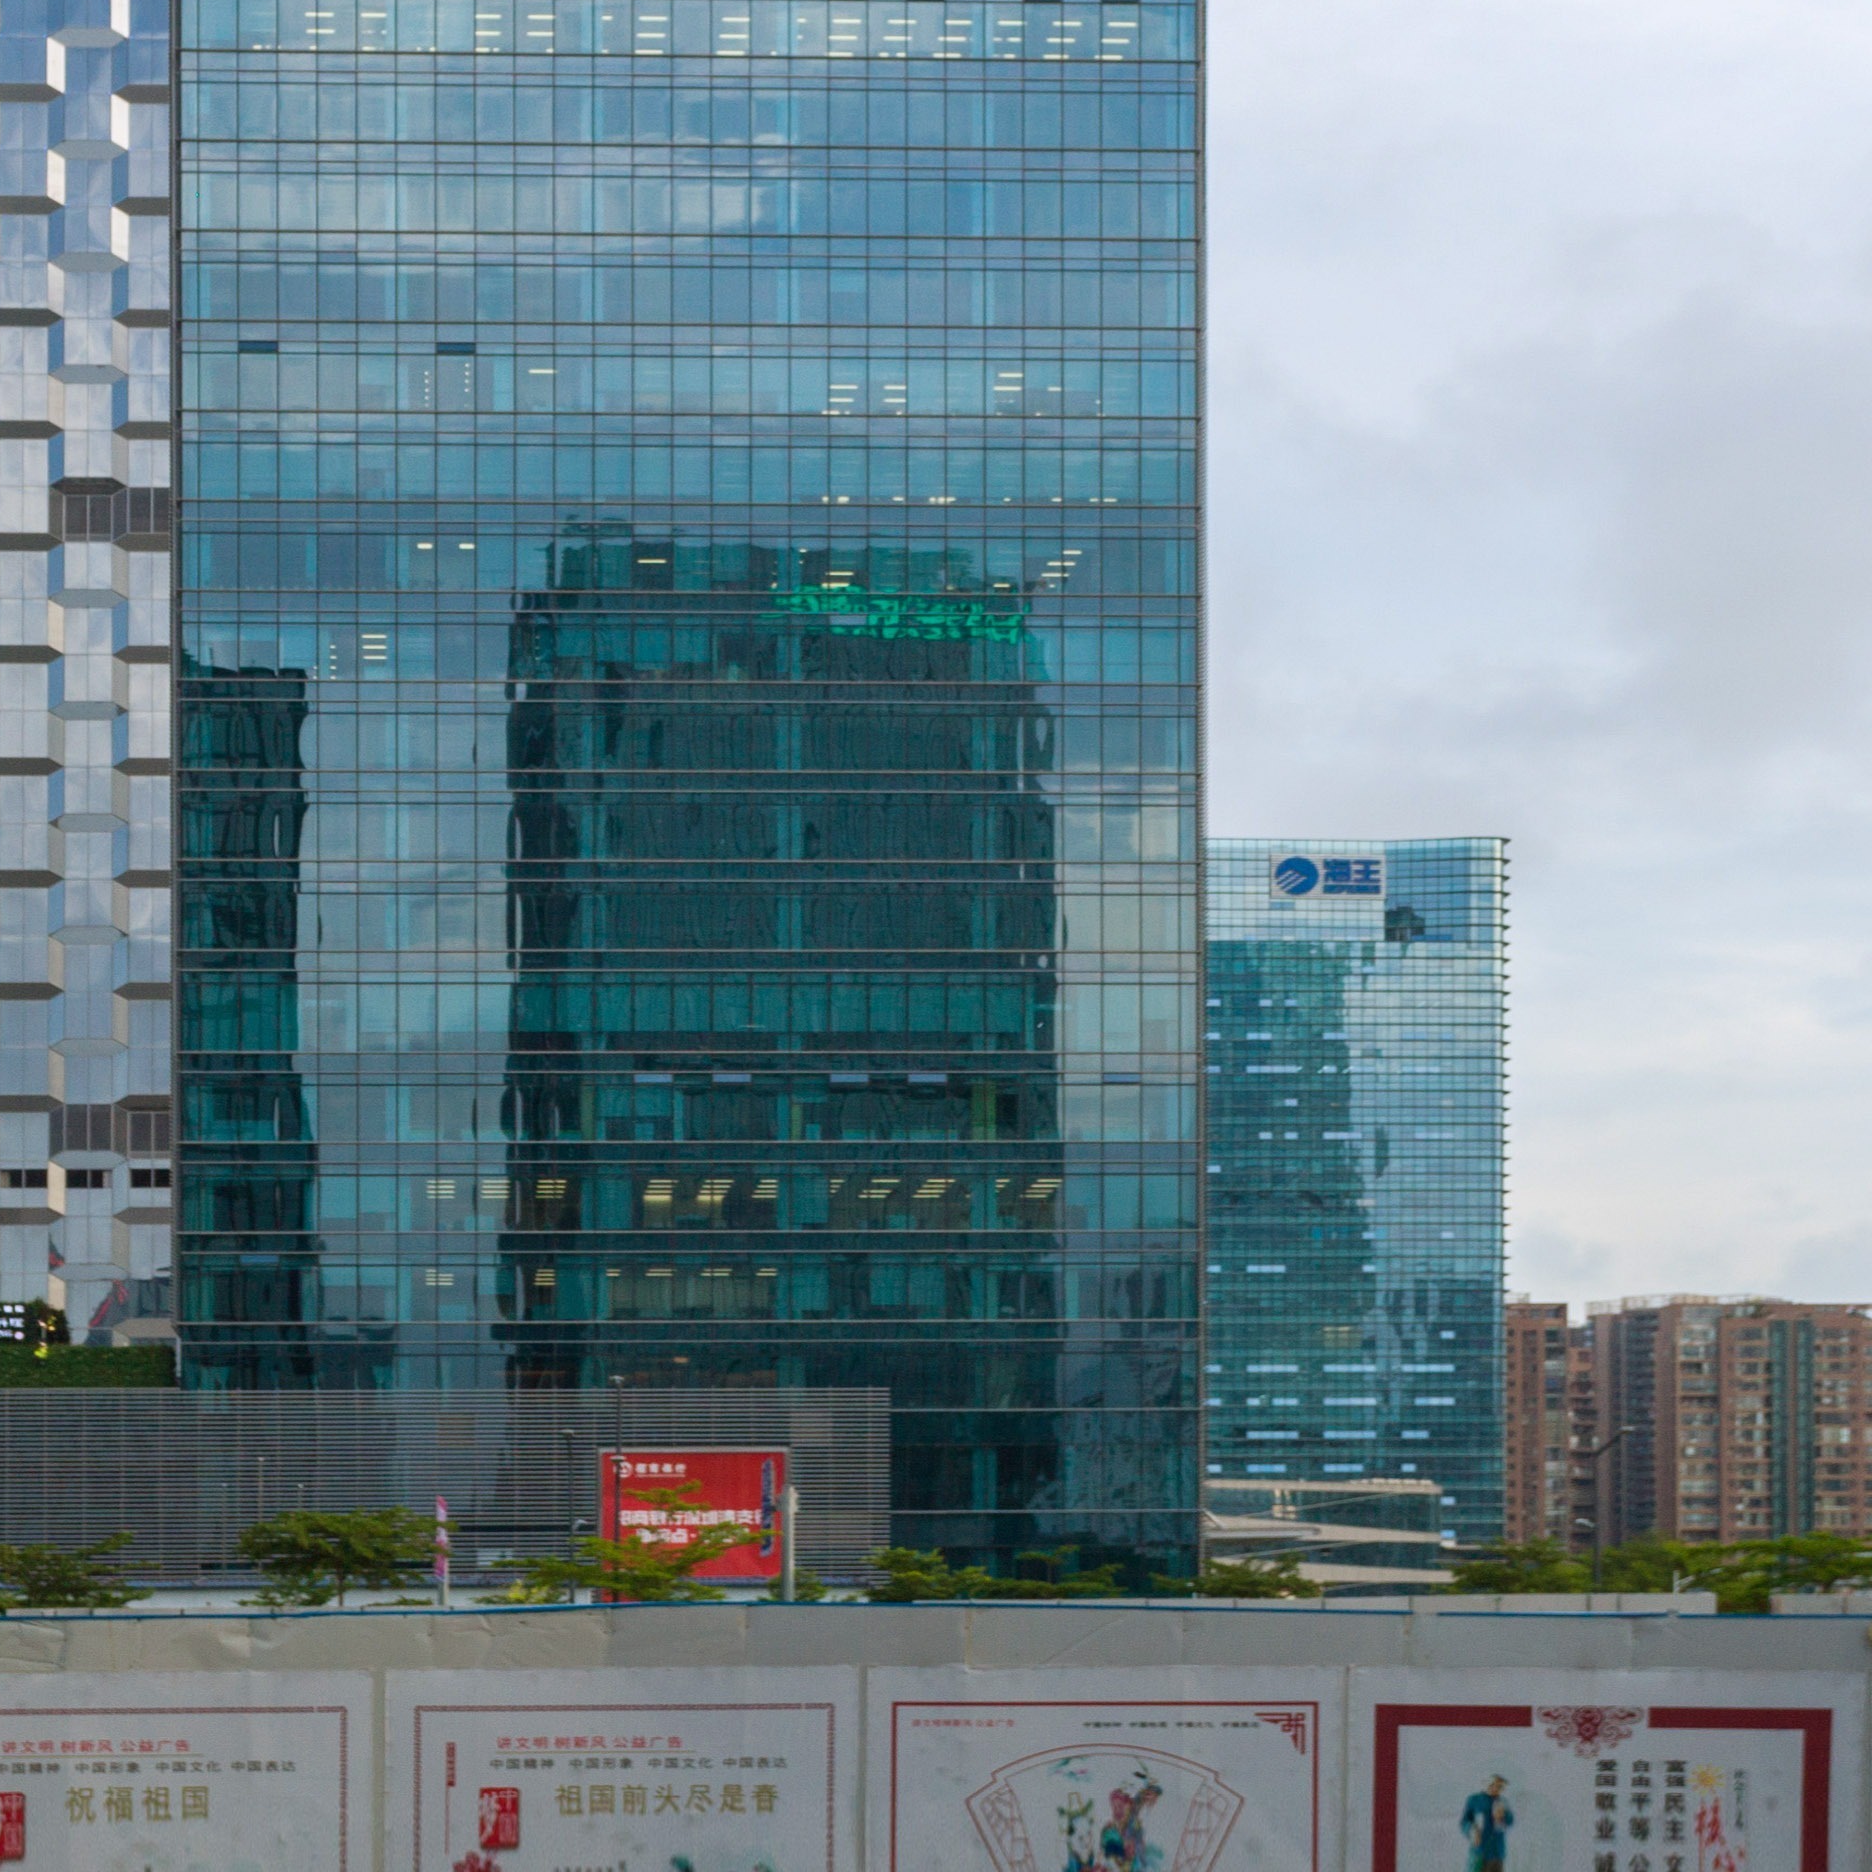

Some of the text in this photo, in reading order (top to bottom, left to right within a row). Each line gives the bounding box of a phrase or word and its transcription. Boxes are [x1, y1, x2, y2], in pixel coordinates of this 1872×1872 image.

[119, 1739, 191, 1753] 公益广告
[65, 1785, 210, 1823] 祝福祖国
